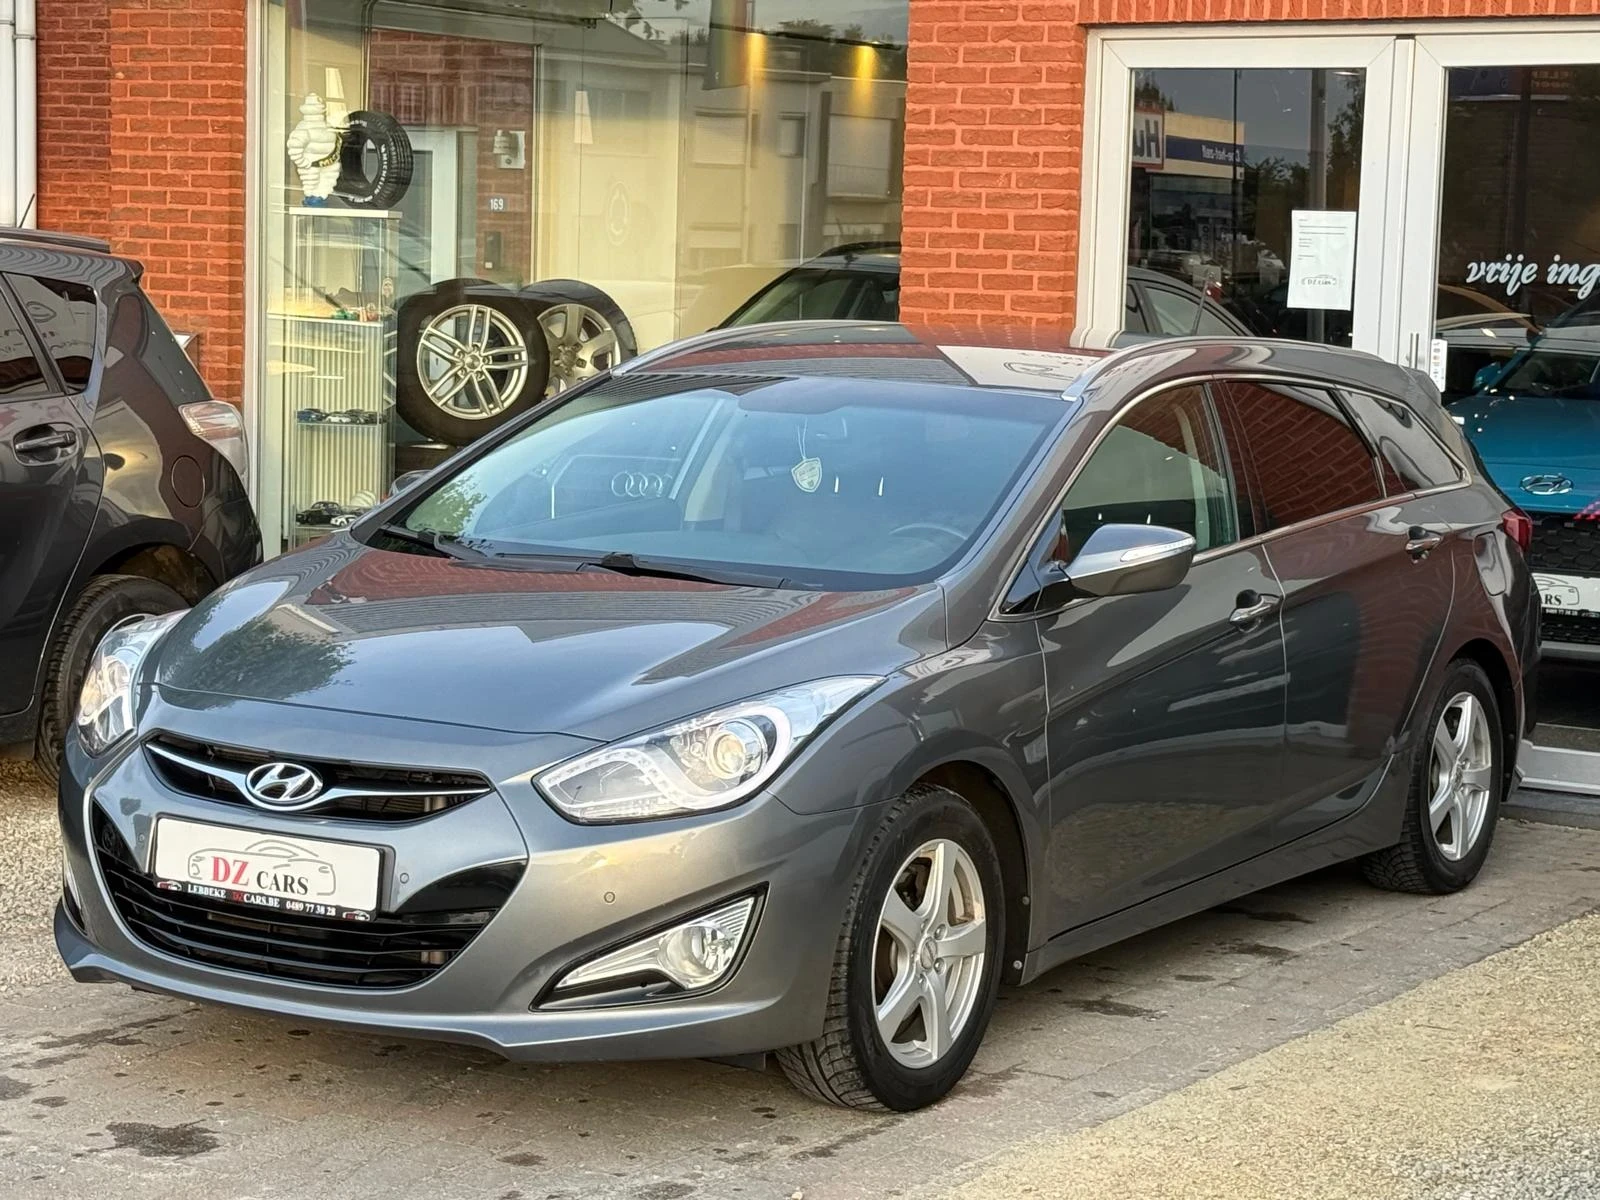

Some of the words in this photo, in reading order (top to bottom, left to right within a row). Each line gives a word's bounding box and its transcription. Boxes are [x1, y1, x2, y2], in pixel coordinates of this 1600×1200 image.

[490, 198, 504, 210] 169
[1465, 253, 1538, 296] vrije
[1546, 253, 1600, 300] ing
[212, 856, 250, 886] DZ
[256, 871, 309, 895] CARS
[305, 902, 315, 913] 77
